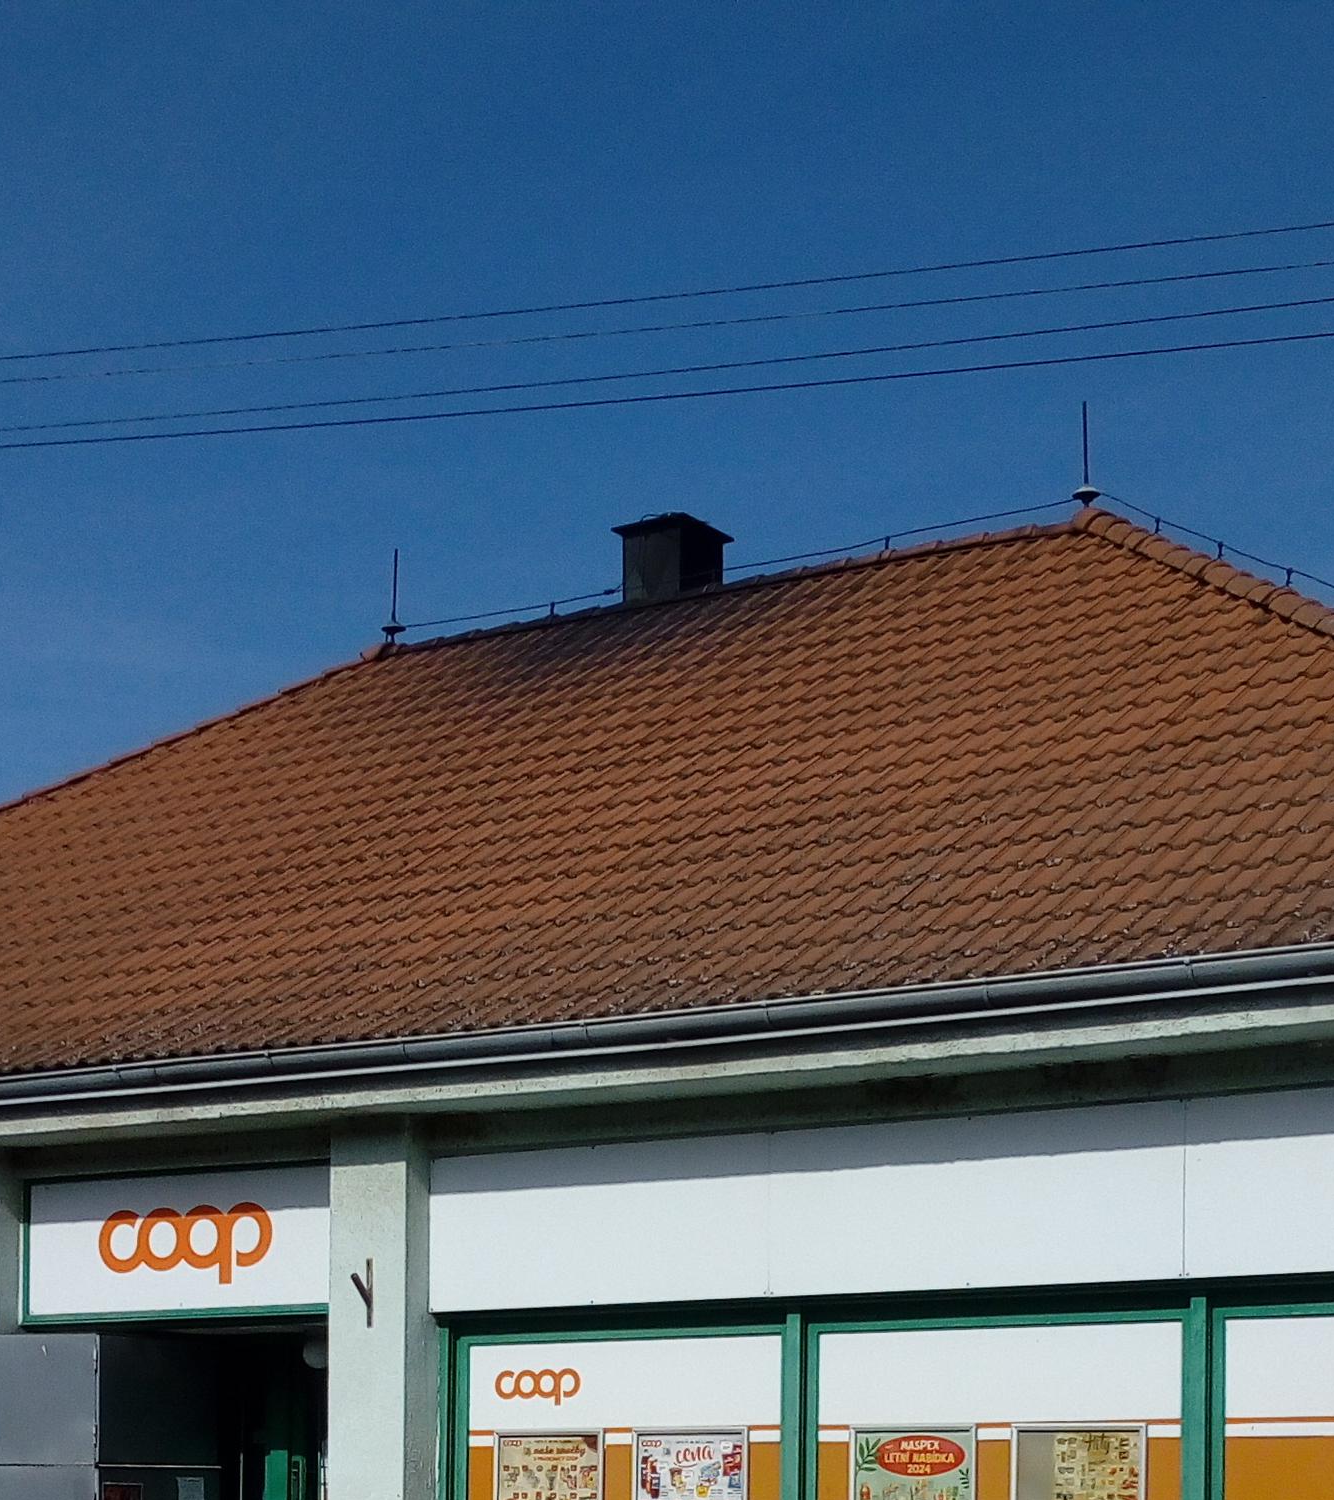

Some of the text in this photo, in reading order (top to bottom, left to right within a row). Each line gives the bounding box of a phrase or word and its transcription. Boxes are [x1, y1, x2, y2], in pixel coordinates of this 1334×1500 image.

[98, 1202, 273, 1284] coop
[494, 1368, 581, 1406] coop
[676, 1445, 715, 1465] cena
[907, 1464, 931, 1474] 2024
